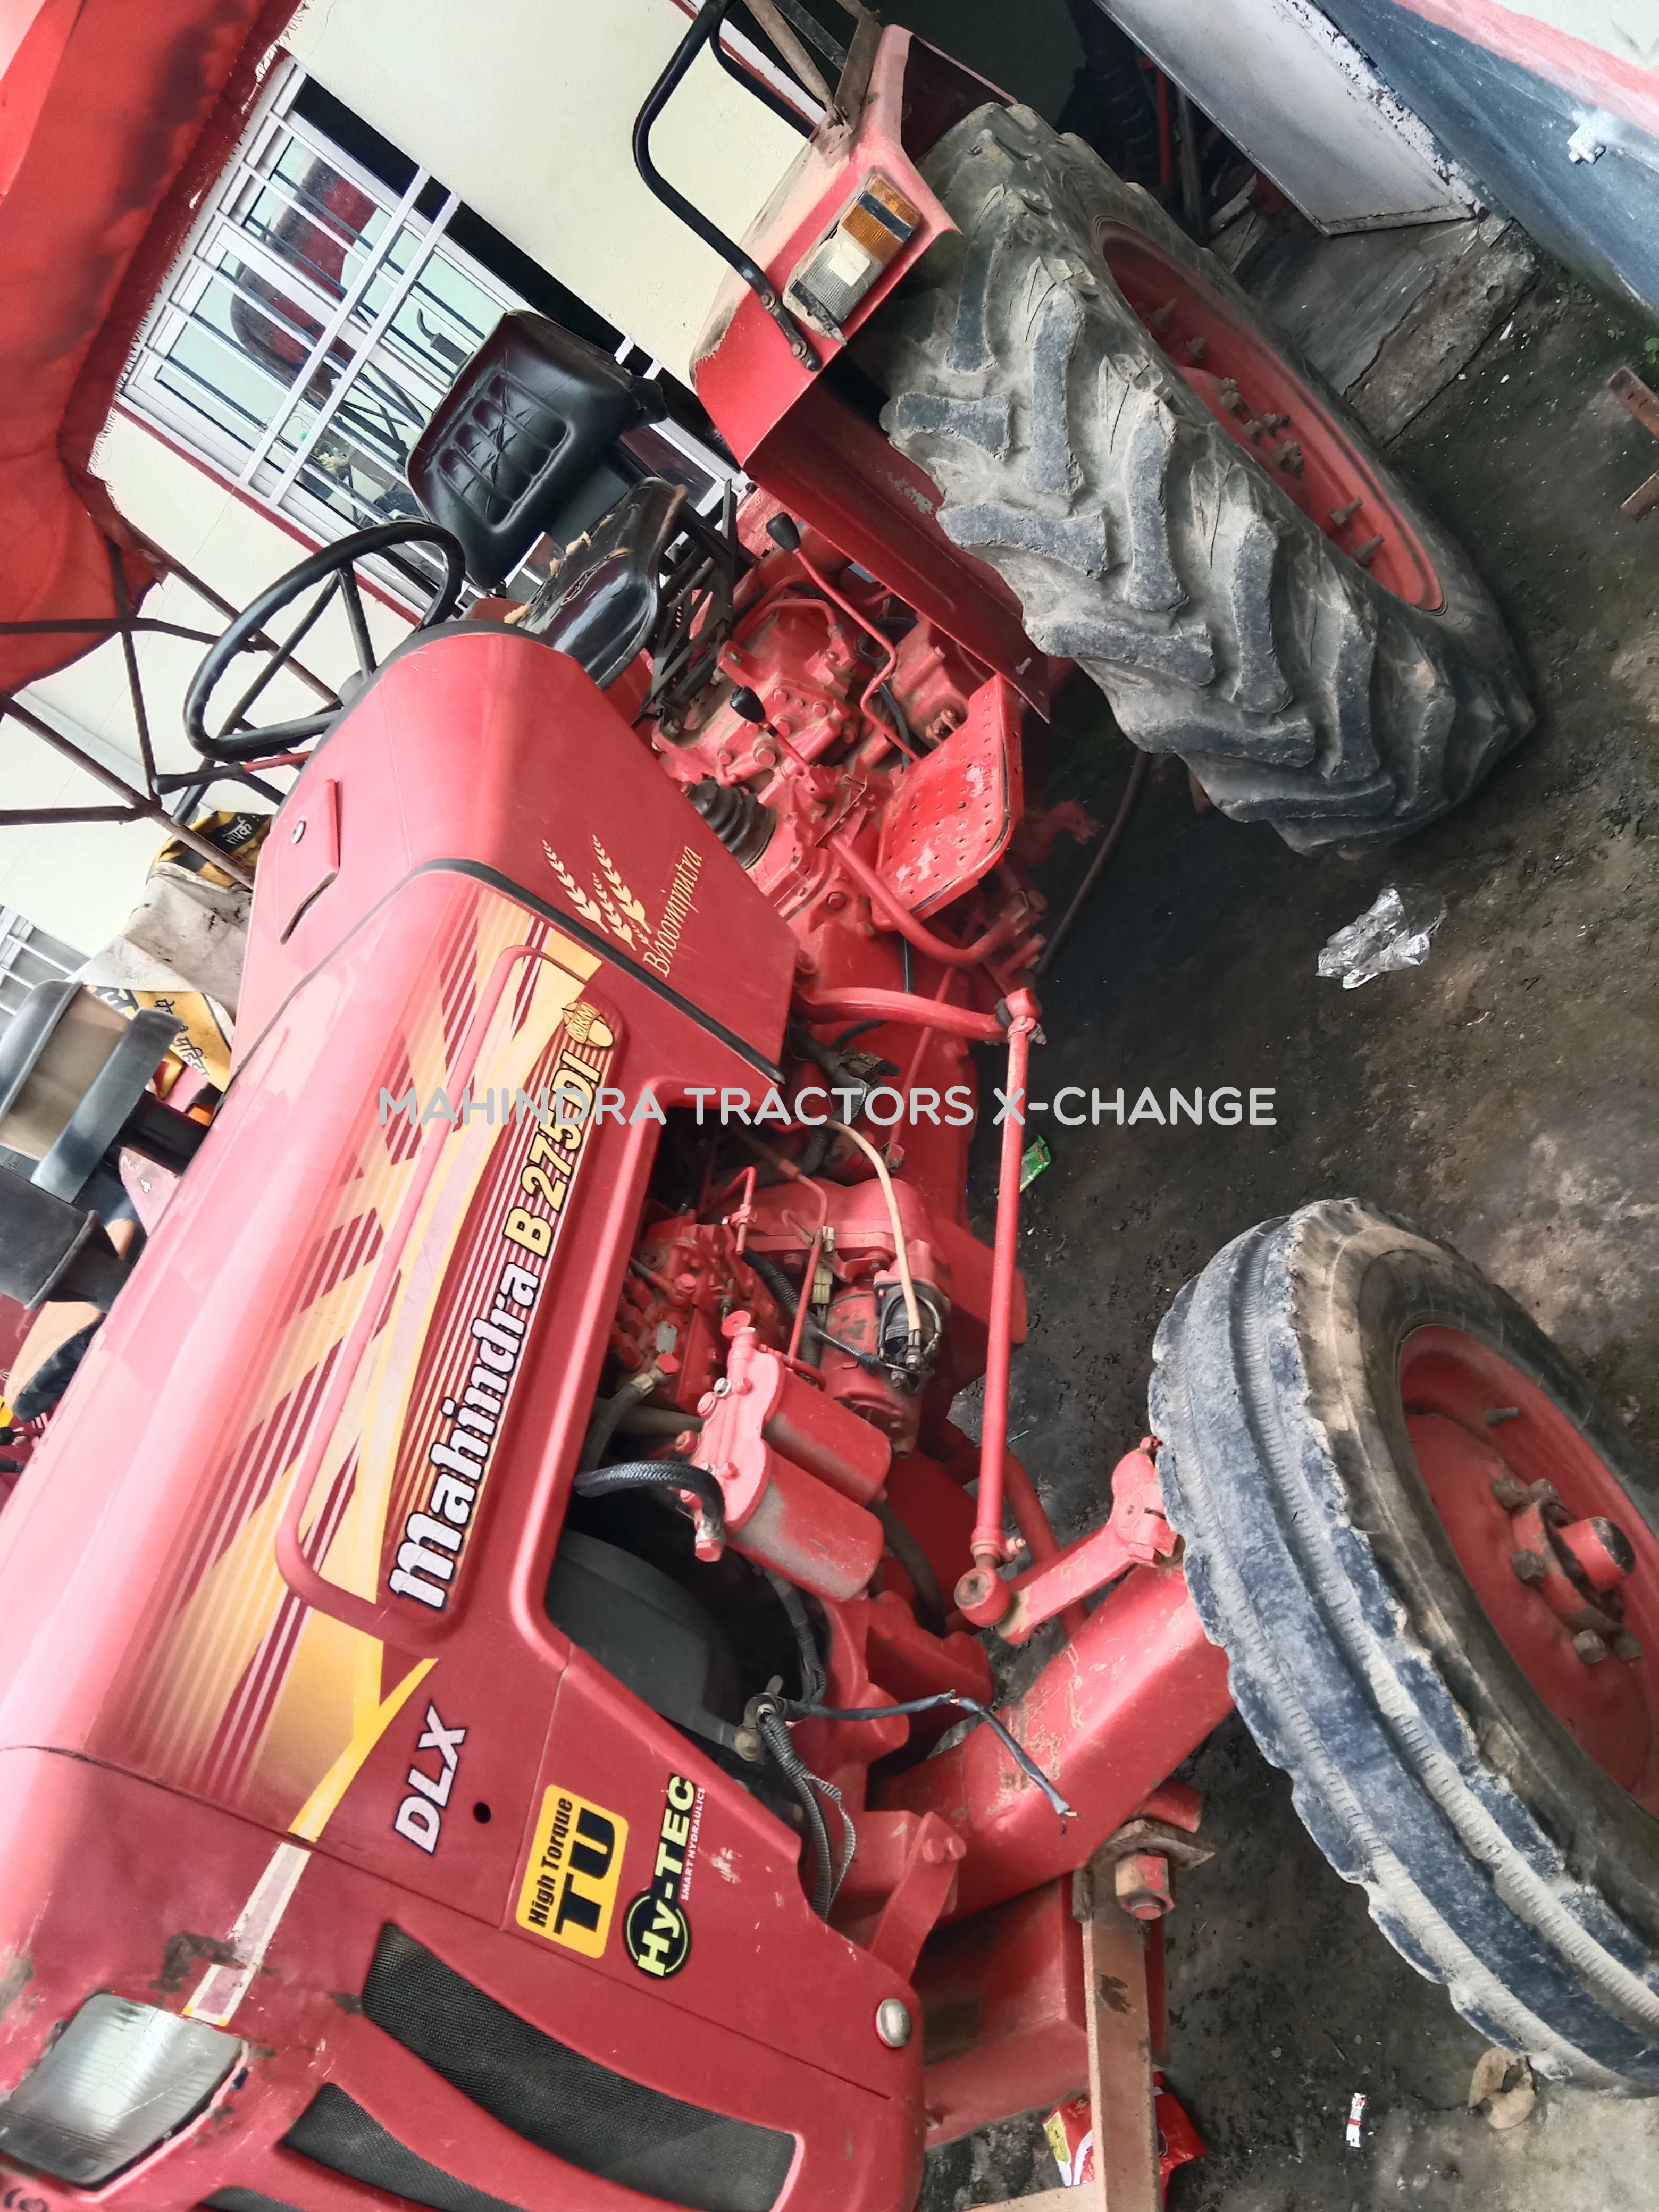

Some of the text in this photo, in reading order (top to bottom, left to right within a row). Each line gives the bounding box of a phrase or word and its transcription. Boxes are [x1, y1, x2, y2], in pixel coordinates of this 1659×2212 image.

[643, 845, 703, 978] Bhoomiputra
[569, 1003, 595, 1040] MKM
[389, 1262, 539, 1611] Mahindra
[502, 1206, 554, 1260] B
[393, 1698, 467, 1856] DLX
[528, 1797, 573, 1928] High Torque
[554, 1807, 615, 1936] TU
[638, 1775, 695, 1977] Hy-TEC
[681, 1787, 706, 1901] SMART HYDRAULICS
